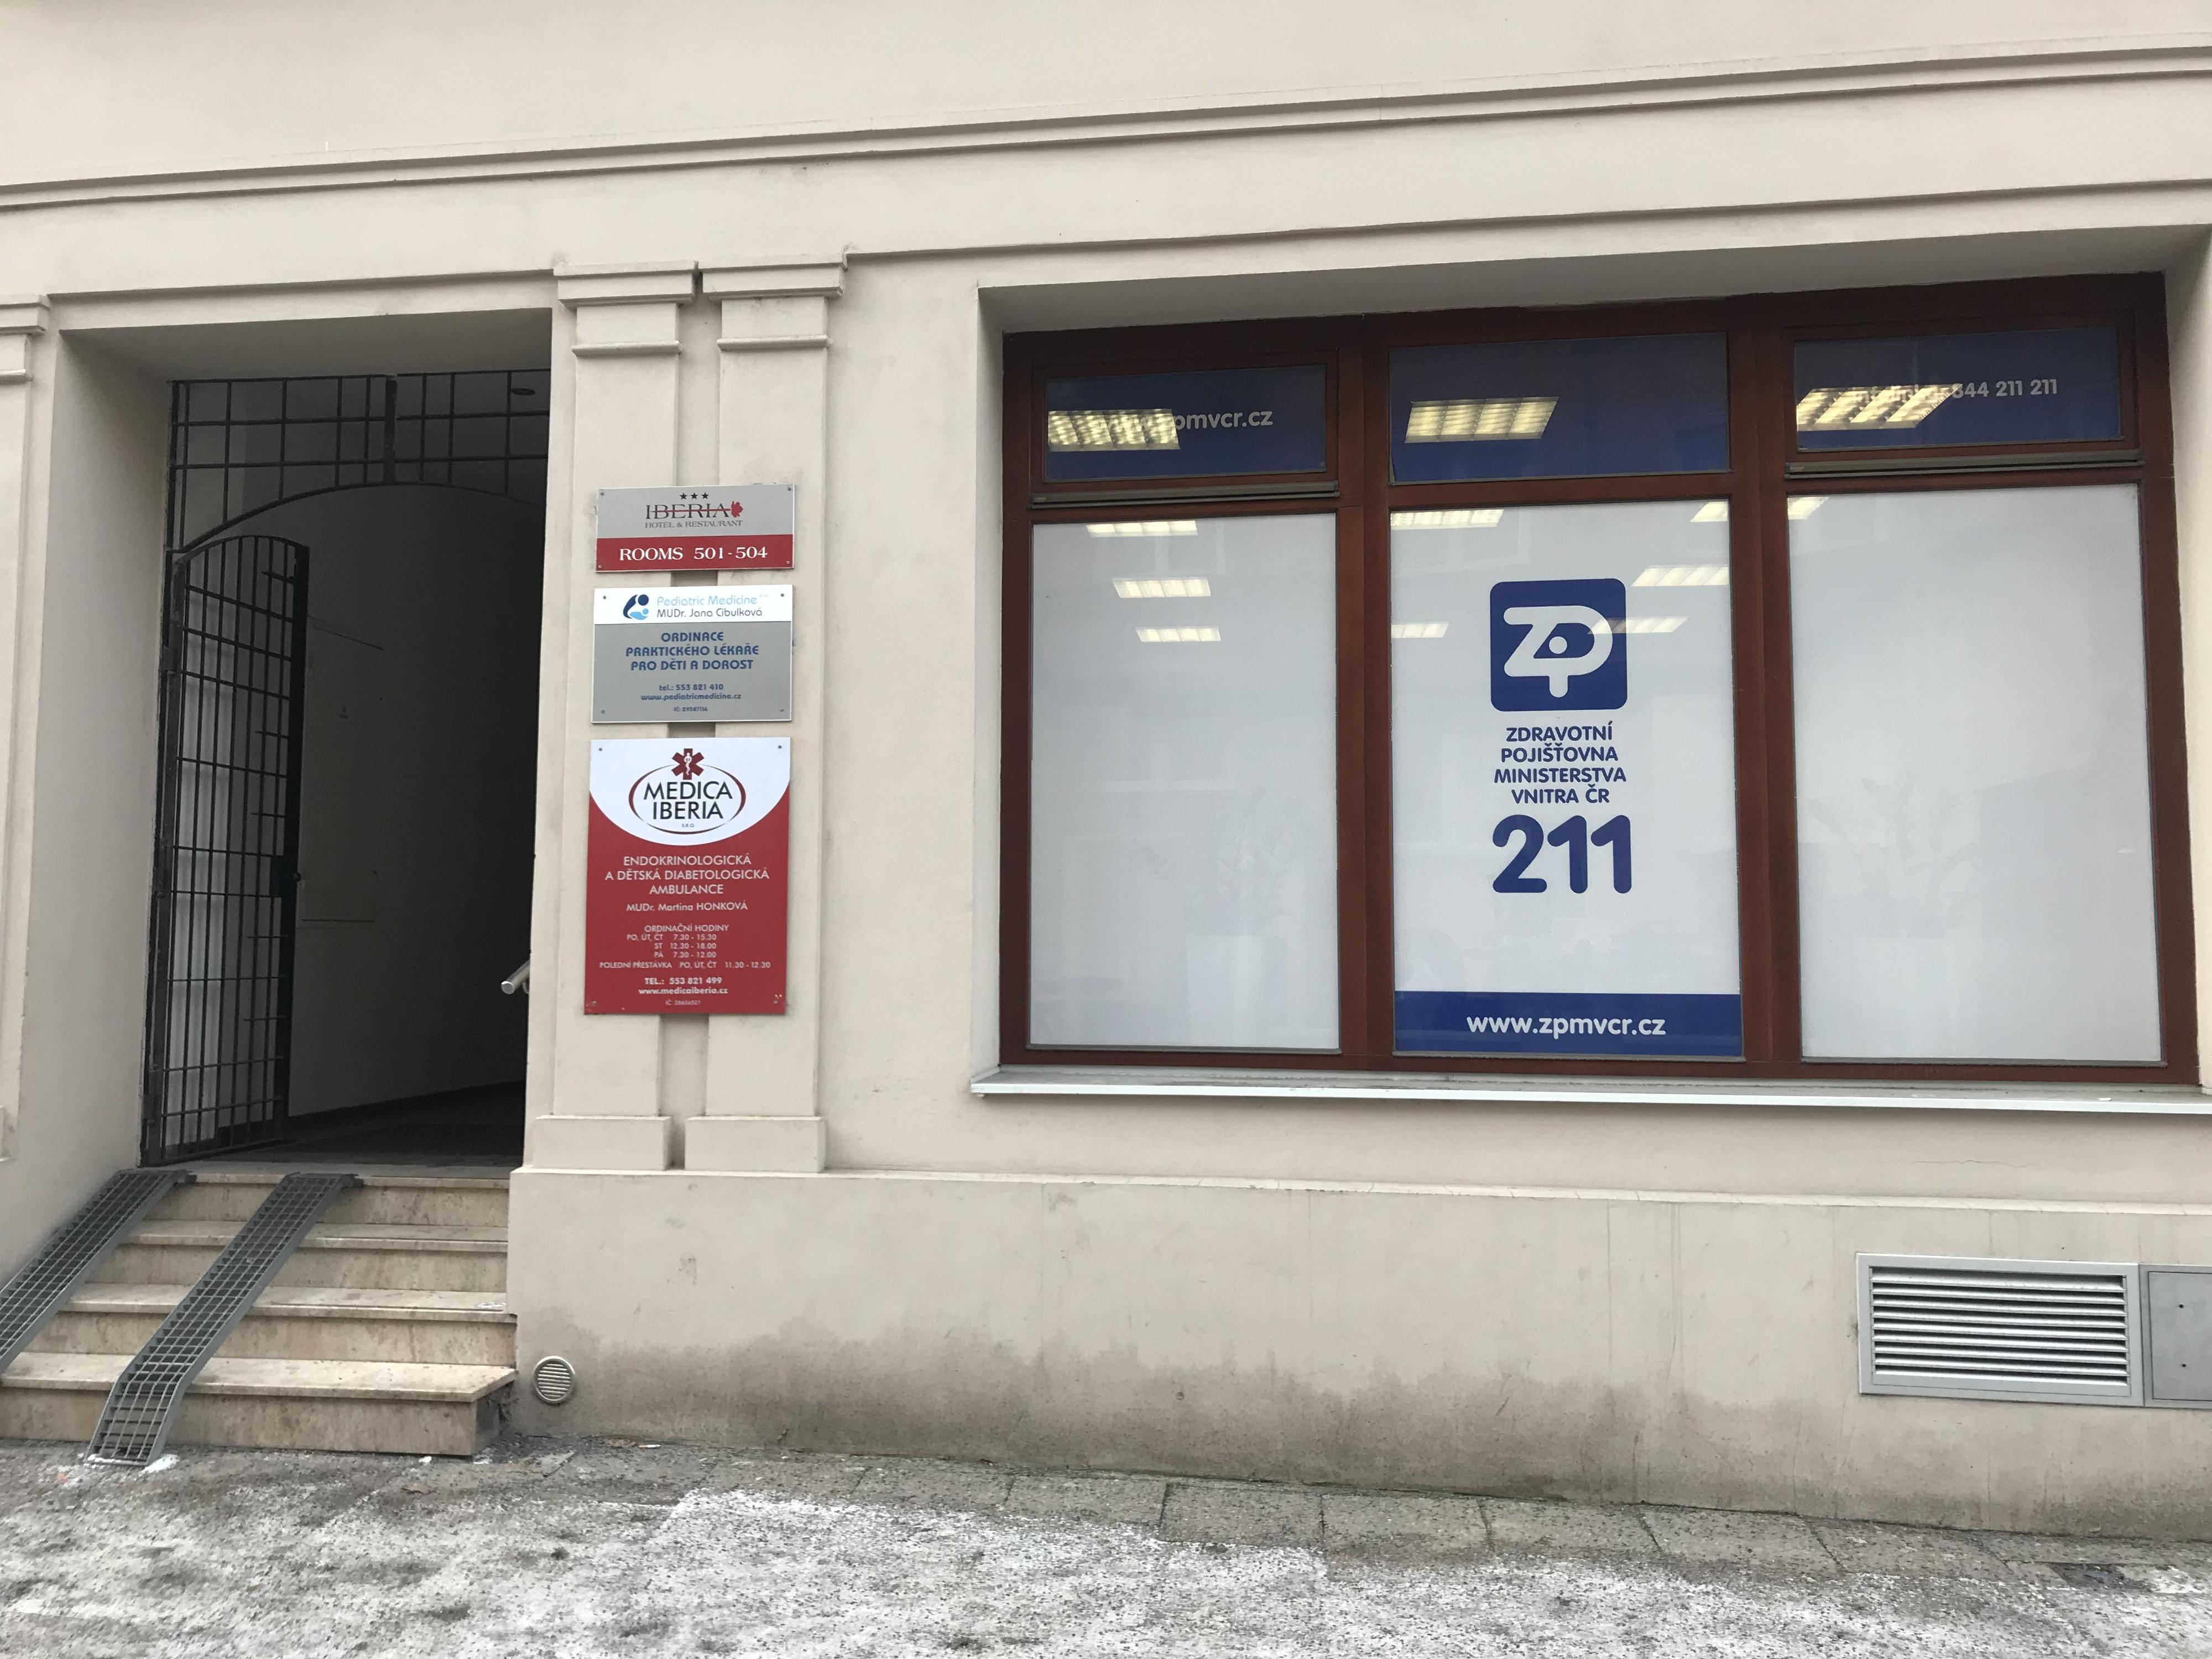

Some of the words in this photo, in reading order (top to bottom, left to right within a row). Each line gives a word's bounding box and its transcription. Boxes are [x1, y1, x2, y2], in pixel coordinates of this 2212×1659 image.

[1996, 380, 2023, 397] 211
[2030, 379, 2057, 395] 211
[646, 503, 730, 519] IBERIA
[619, 547, 684, 561] ROOMS
[657, 597, 705, 606] Pediatric
[708, 595, 758, 605] Medicine
[656, 609, 686, 618] MUDr.
[689, 608, 713, 618] Jana
[716, 607, 763, 617] Cibulková
[661, 632, 724, 642] ORDINACE
[625, 644, 710, 657] PRAKTICKÉHO
[714, 643, 759, 655] LÉKAŘE
[631, 661, 656, 671] PRO
[660, 658, 686, 670] DĚTI
[691, 660, 699, 670] A
[702, 659, 753, 670] DOROST
[641, 692, 742, 701] www.pediatricmedicine.cz
[1506, 721, 1613, 743] ZDRAVOTNÍ
[1501, 742, 1619, 763] POJIŠŤOVNA
[1494, 768, 1626, 784] MINISTERSTVA
[644, 781, 733, 800] MEDICA
[1511, 788, 1579, 804] VNITRA
[1585, 784, 1610, 804] ČR
[653, 801, 724, 820] IBERIA
[623, 853, 752, 866] ENDOKRINOLOGICKÁ
[1493, 814, 1632, 894] 211
[605, 870, 614, 880] A
[617, 868, 661, 880] DĚTSKÁ
[665, 867, 770, 880] DIABETOLOGICKÁ
[650, 884, 724, 894] AMBULANCE
[627, 903, 655, 911] MUDr.
[658, 902, 693, 911] Martina
[696, 900, 748, 910] HONKOVÁ
[644, 923, 692, 932] ORDINAČNÍ
[633, 960, 672, 968] PŘESTÁVKA
[1467, 1015, 1666, 1039] www.zpmvcr.cz
